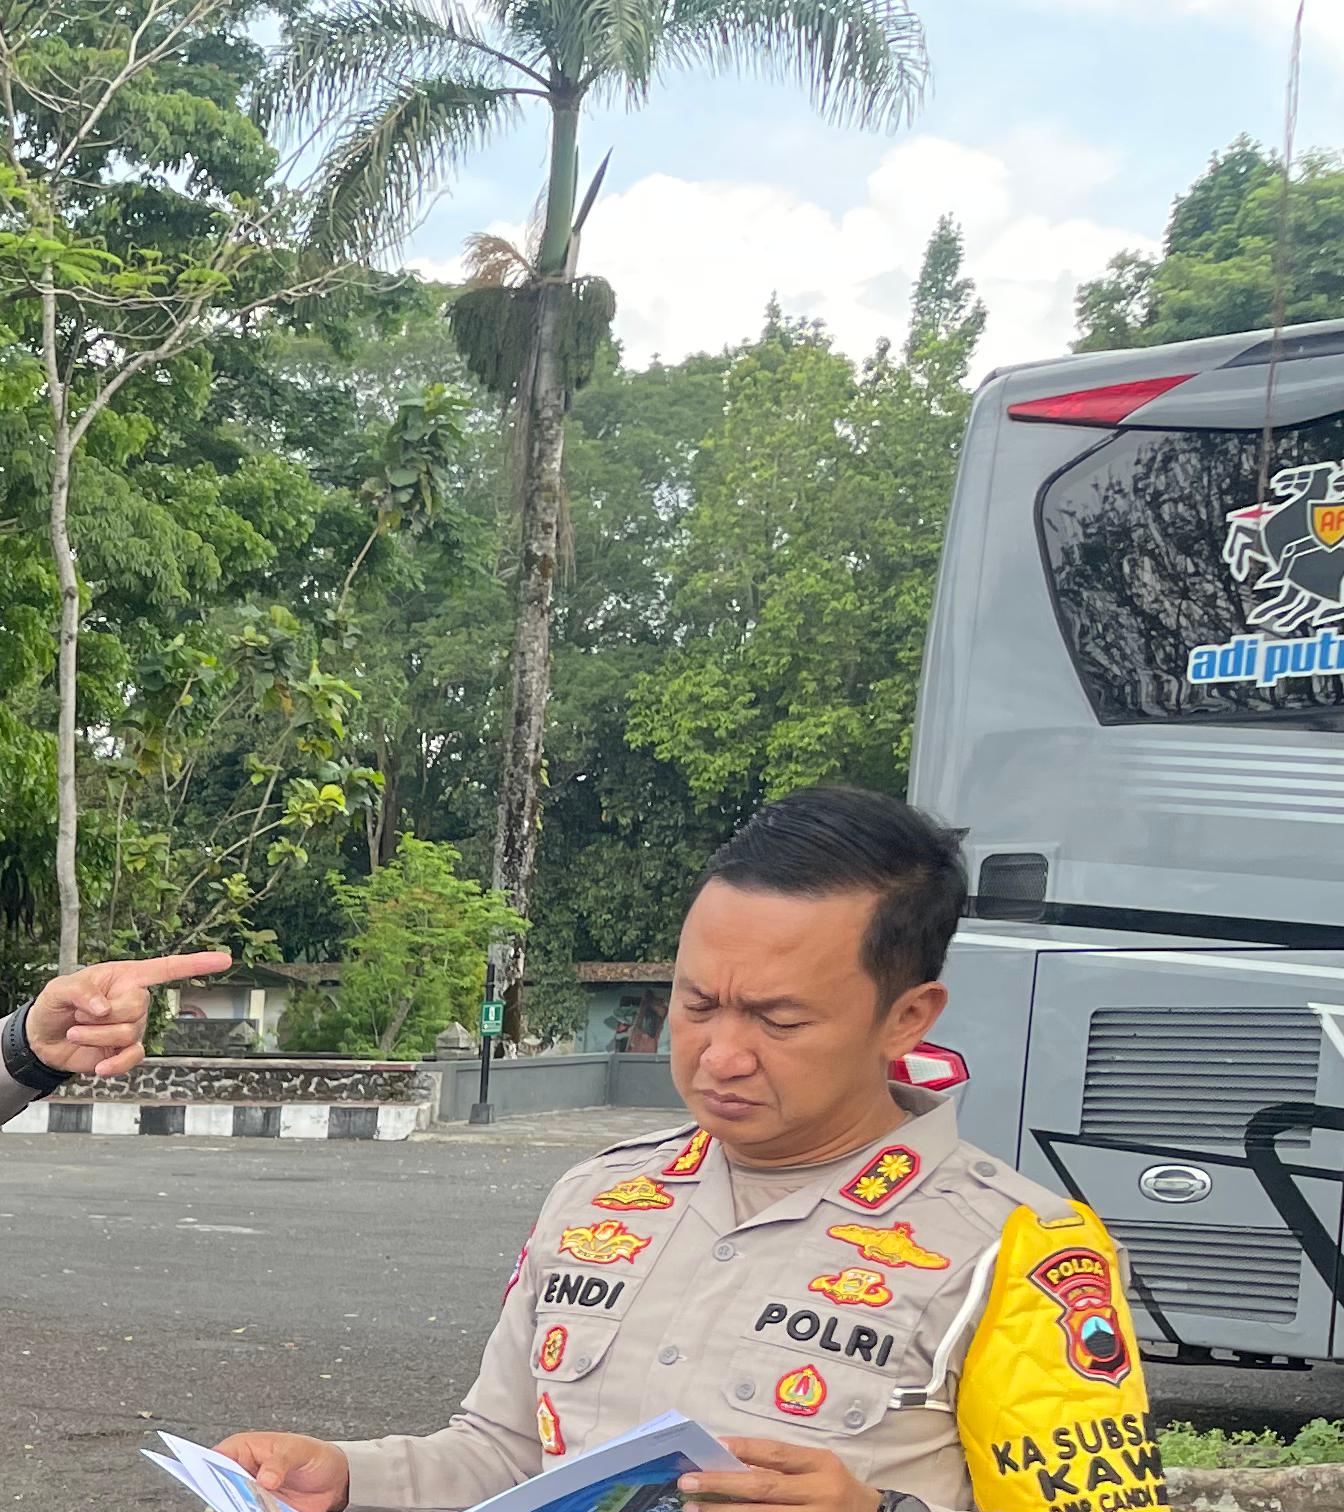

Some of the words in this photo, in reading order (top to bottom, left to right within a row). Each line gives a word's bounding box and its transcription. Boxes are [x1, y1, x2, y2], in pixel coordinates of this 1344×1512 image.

[1191, 638, 1258, 681] adi
[544, 1273, 625, 1310] ENDI
[1046, 1258, 1105, 1285] POLDA
[754, 1302, 894, 1367] POLRI
[991, 1435, 1047, 1476] KA
